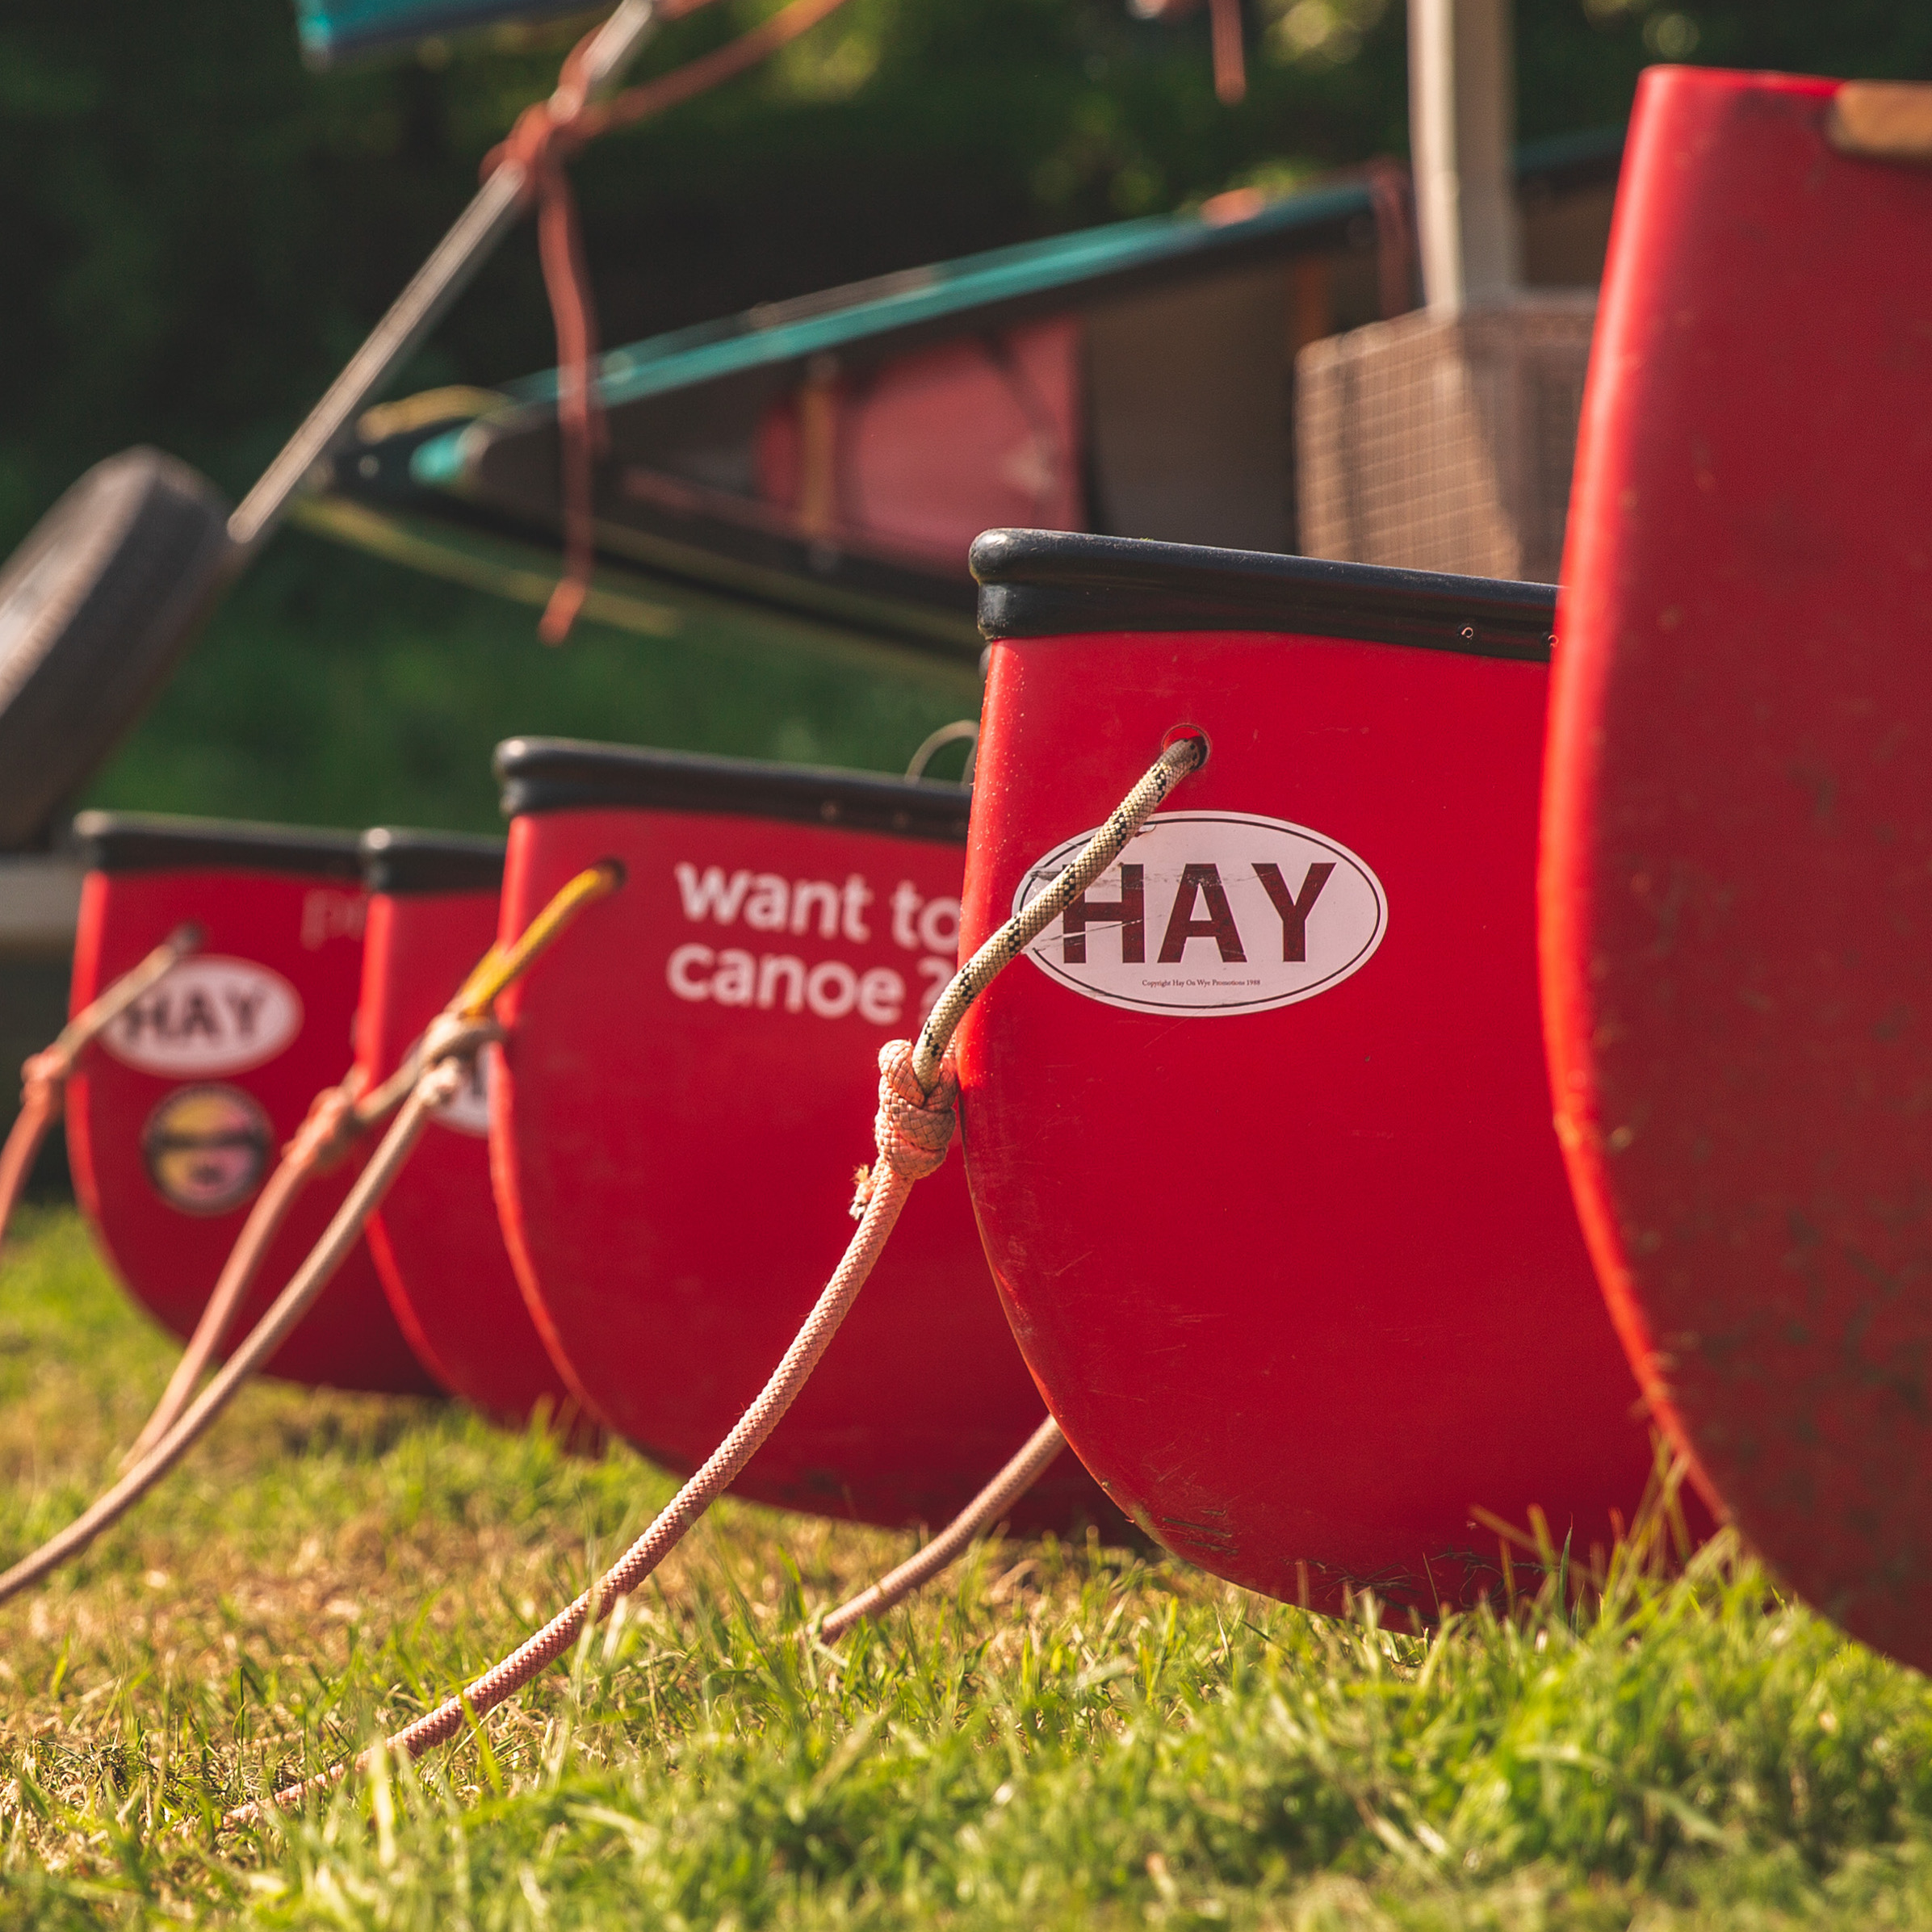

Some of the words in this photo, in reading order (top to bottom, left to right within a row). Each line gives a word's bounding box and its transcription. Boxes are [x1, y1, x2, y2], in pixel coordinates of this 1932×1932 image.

[674, 861, 874, 945] want
[891, 880, 961, 954] to
[1062, 861, 1337, 963] HAY
[666, 942, 905, 1025] canoe
[1142, 979, 1171, 987] Copyright
[1172, 979, 1184, 987] Hay
[1196, 979, 1210, 987] Wye
